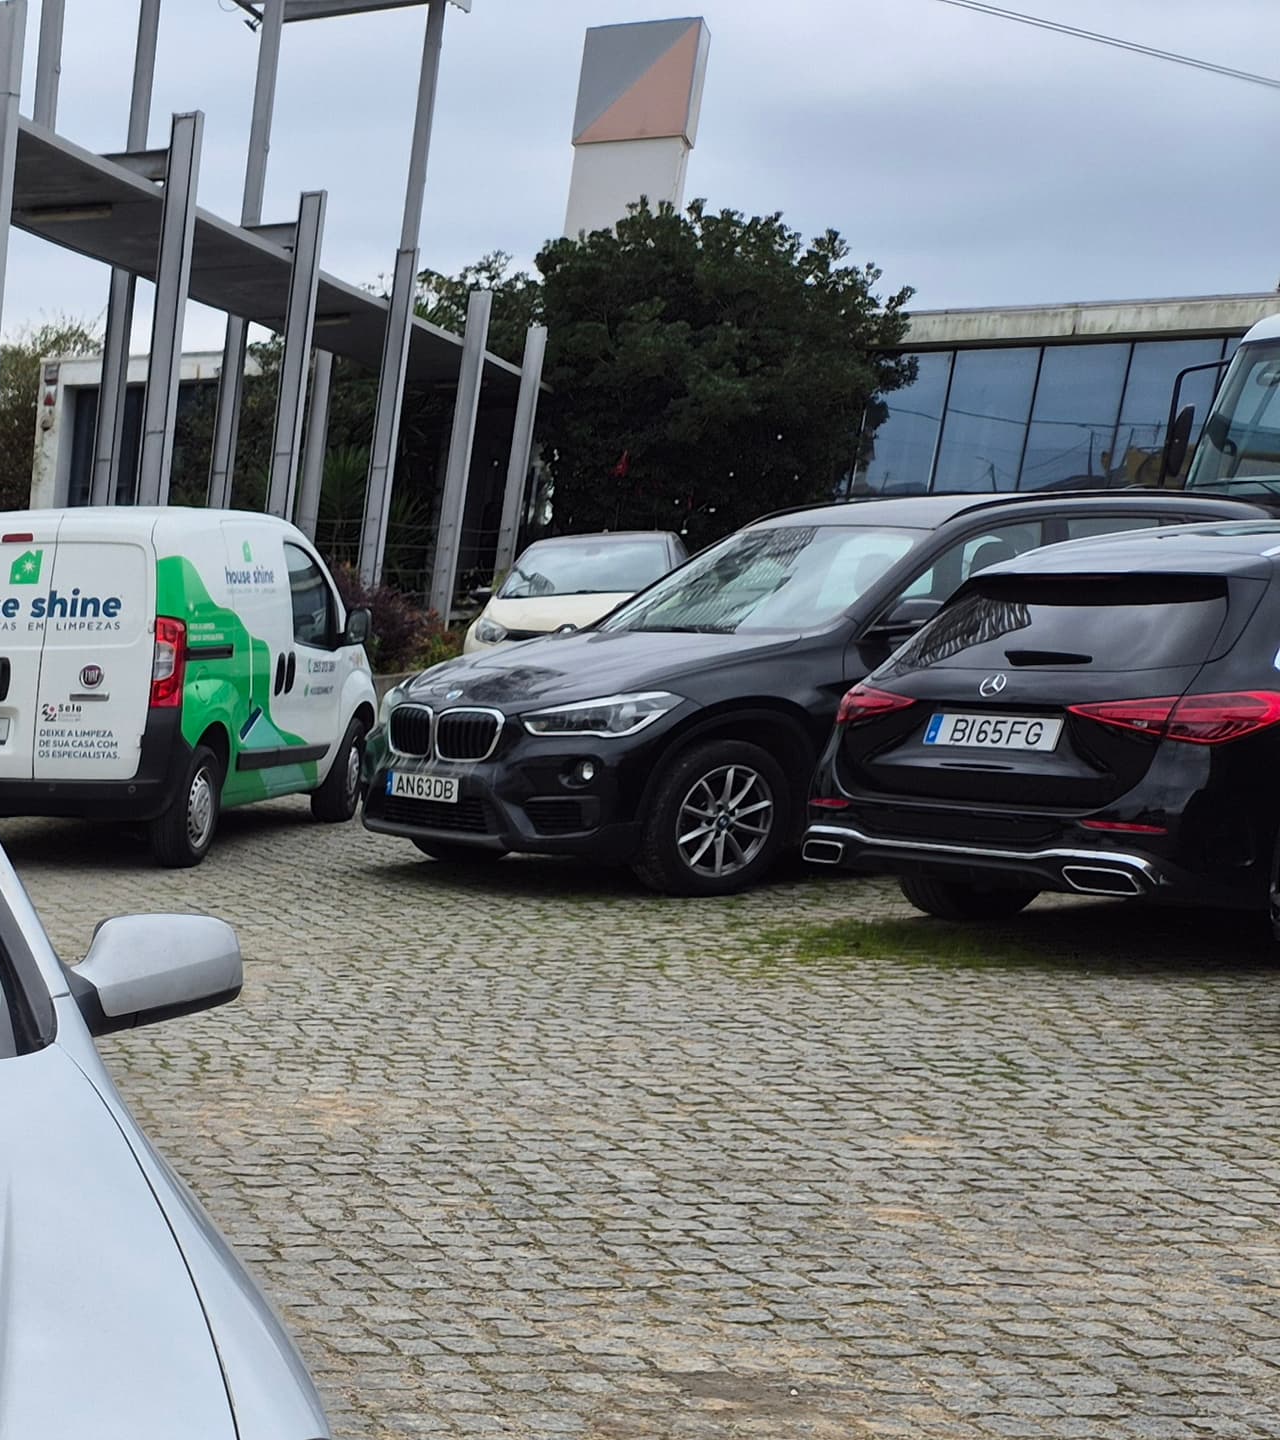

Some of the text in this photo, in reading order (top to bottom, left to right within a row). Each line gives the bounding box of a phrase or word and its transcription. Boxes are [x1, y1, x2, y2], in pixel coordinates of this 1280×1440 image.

[225, 565, 274, 584] house shine
[30, 588, 122, 618] shine
[27, 621, 44, 631] EM
[56, 620, 121, 631] LIMPEZAS
[58, 704, 82, 713] Selo
[39, 729, 66, 737] DEIXE
[75, 730, 114, 738] LIMPEZA
[950, 718, 1044, 746] BI65FG
[39, 740, 51, 748] DE
[52, 740, 70, 748] SUA
[97, 741, 119, 749] COM
[396, 775, 454, 800] AN63DB
